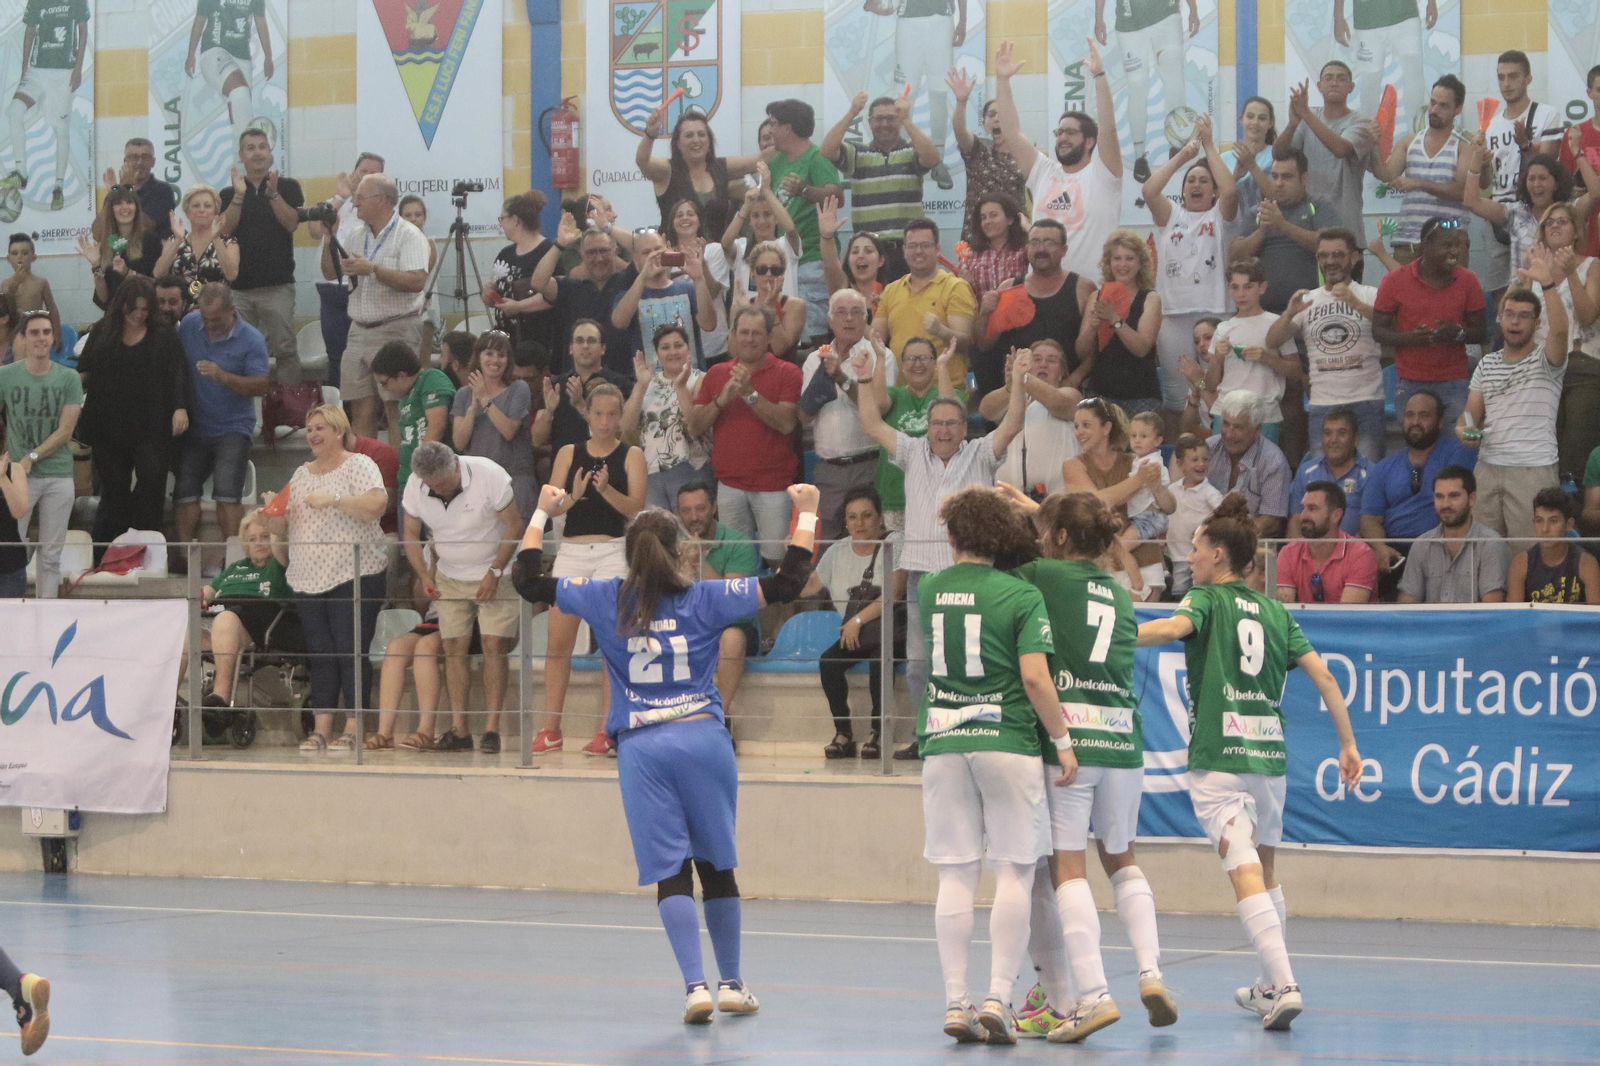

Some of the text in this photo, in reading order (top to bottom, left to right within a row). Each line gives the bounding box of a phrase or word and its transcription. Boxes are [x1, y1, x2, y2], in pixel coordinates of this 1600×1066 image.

[935, 592, 975, 606] LORENA
[1087, 581, 1114, 600] CLARA
[627, 634, 691, 683] 21
[931, 612, 985, 677] 11
[1087, 600, 1116, 663] 7
[1237, 618, 1265, 677] 9
[1410, 743, 1573, 806] Cádiz
